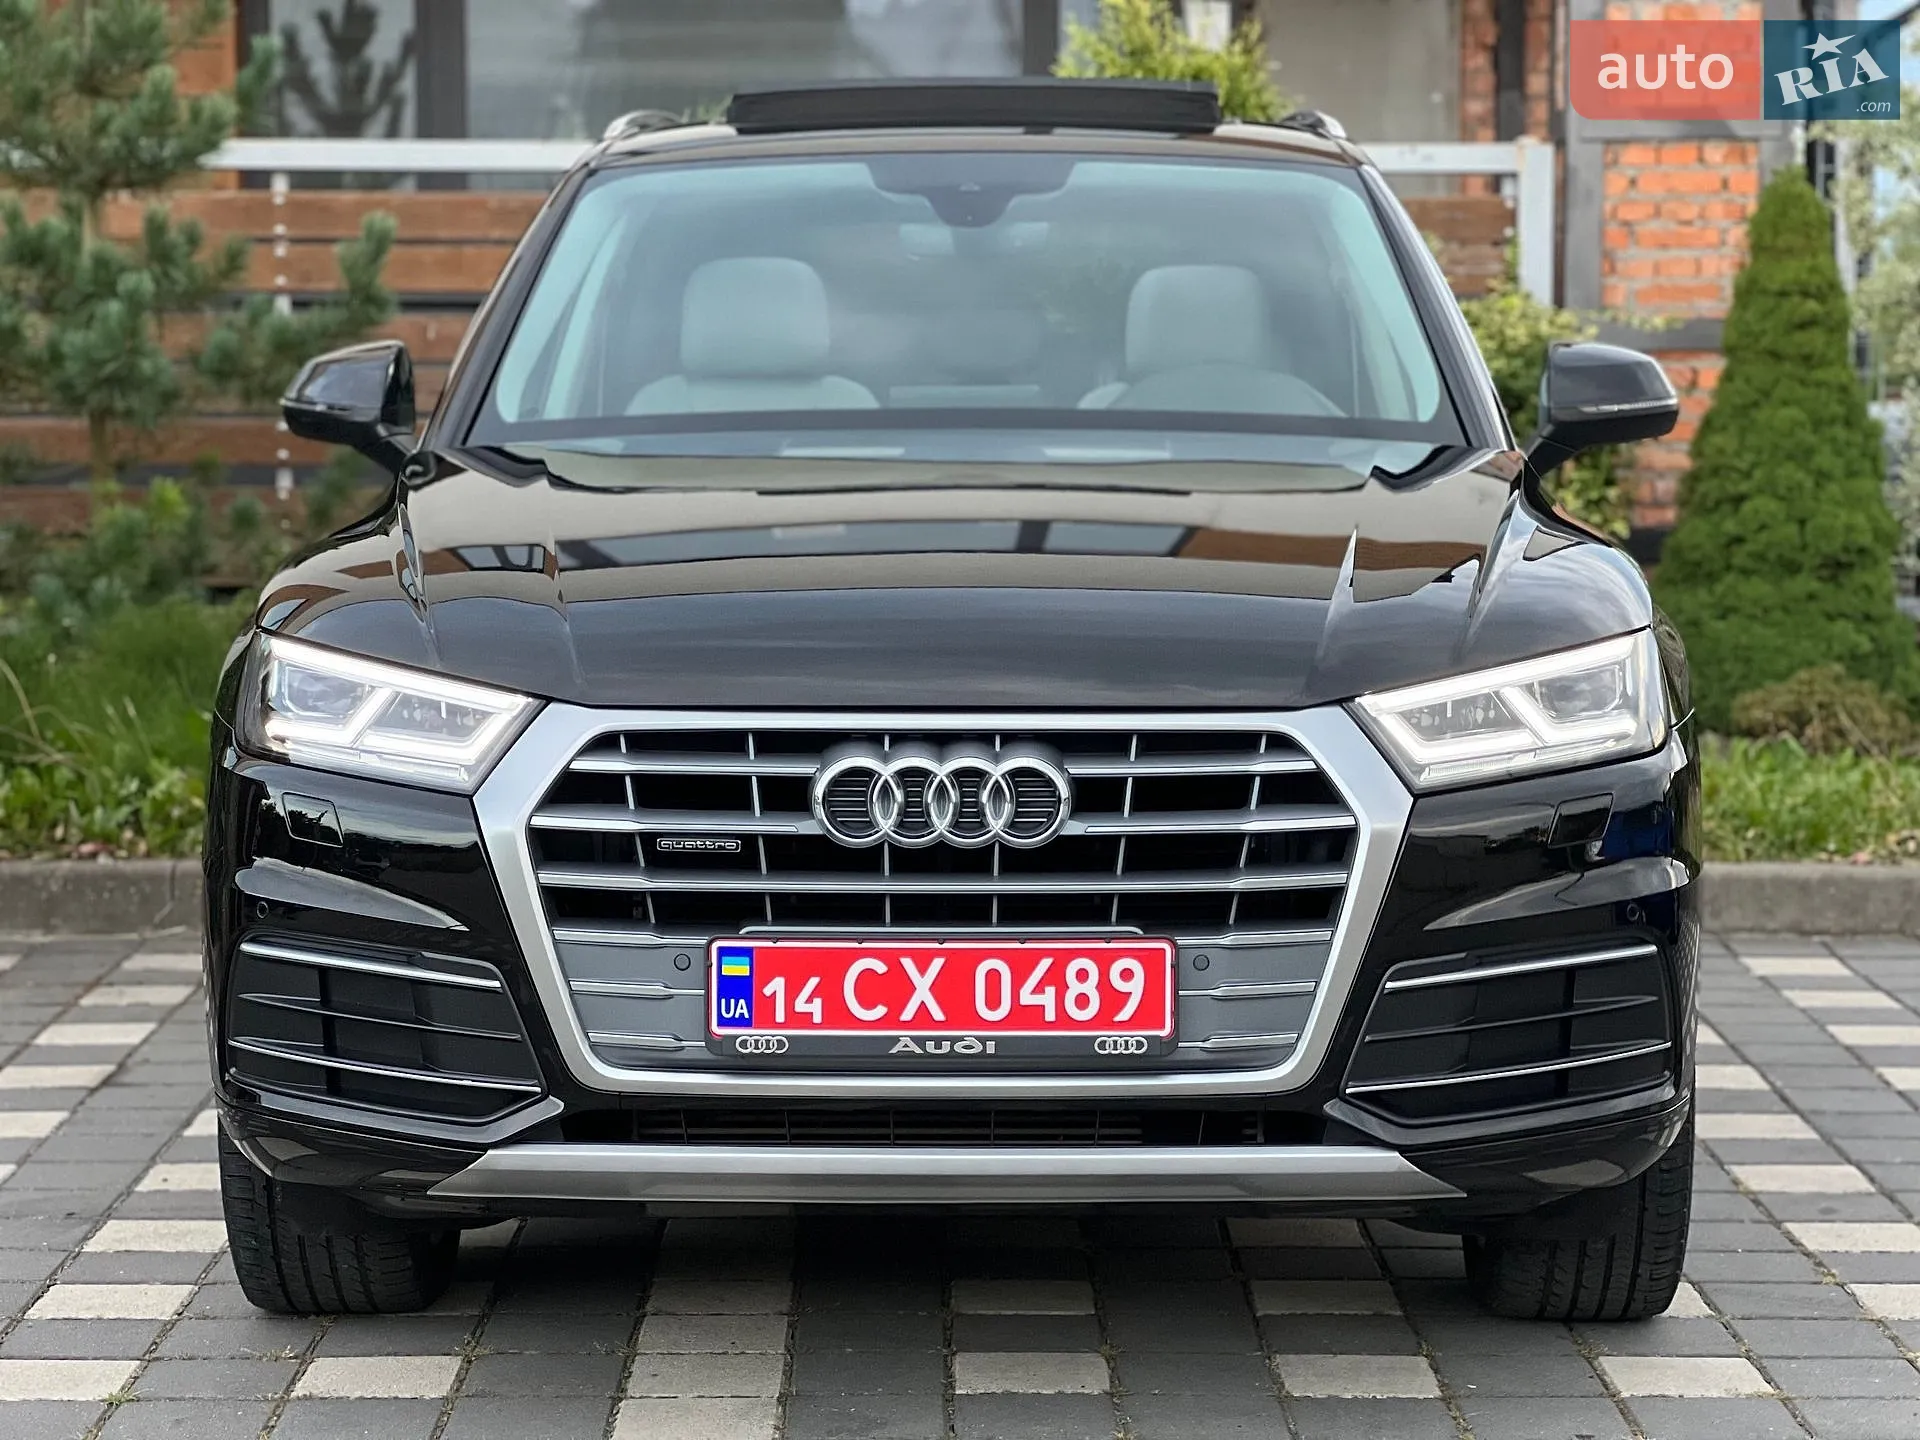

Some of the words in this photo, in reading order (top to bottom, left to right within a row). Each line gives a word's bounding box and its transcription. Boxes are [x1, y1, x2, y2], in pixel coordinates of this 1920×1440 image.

[660, 840, 737, 850] quattro
[762, 977, 822, 1024] 14
[843, 957, 946, 1023] CX
[974, 957, 1145, 1023] 0489
[720, 999, 749, 1019] UA
[888, 1036, 997, 1055] Audi
